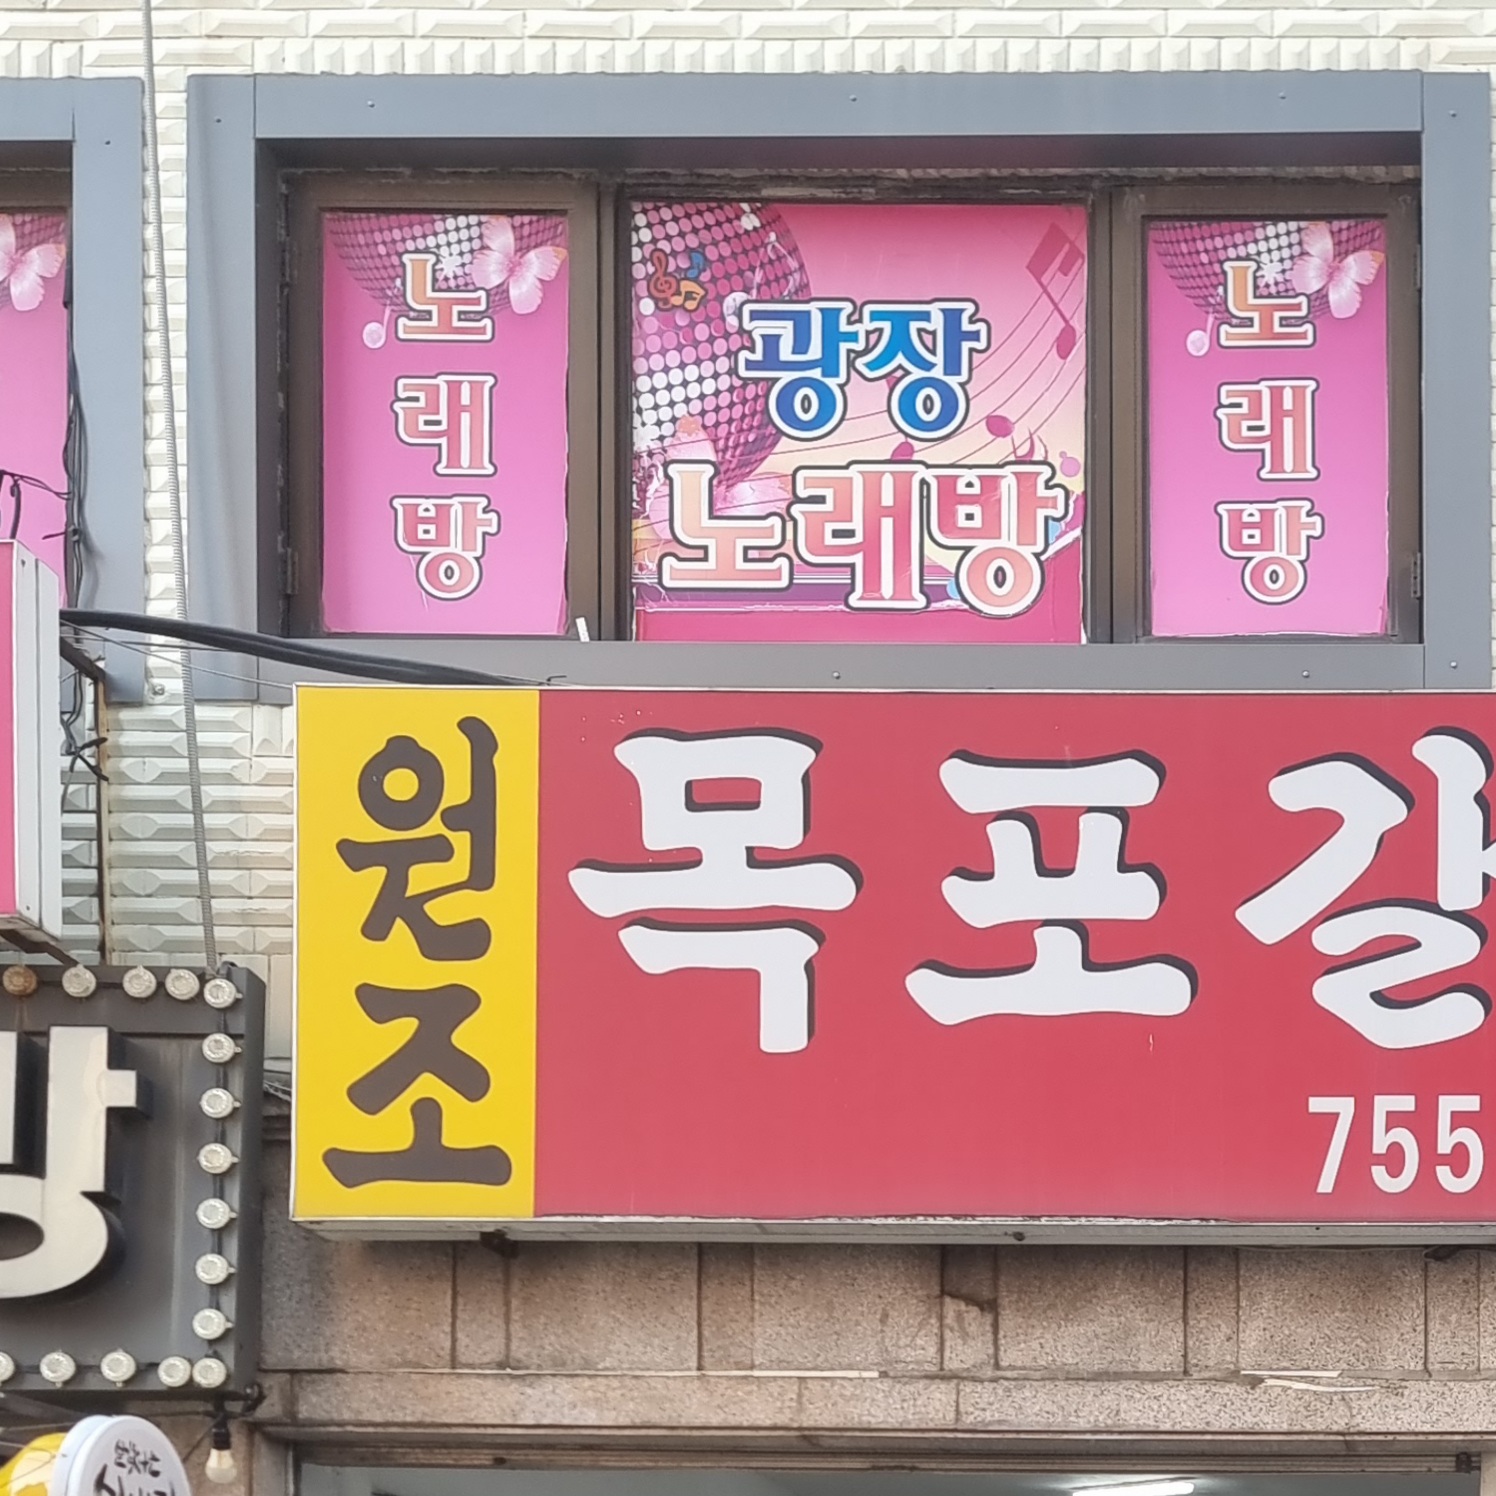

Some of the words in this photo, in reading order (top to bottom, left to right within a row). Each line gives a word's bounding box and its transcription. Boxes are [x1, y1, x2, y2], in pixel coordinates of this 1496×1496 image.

[393, 252, 500, 600] 노래방
[658, 459, 1070, 617] 노래방
[736, 298, 991, 441] 광장
[1216, 259, 1325, 604] 노래방
[322, 715, 512, 1189] 원조
